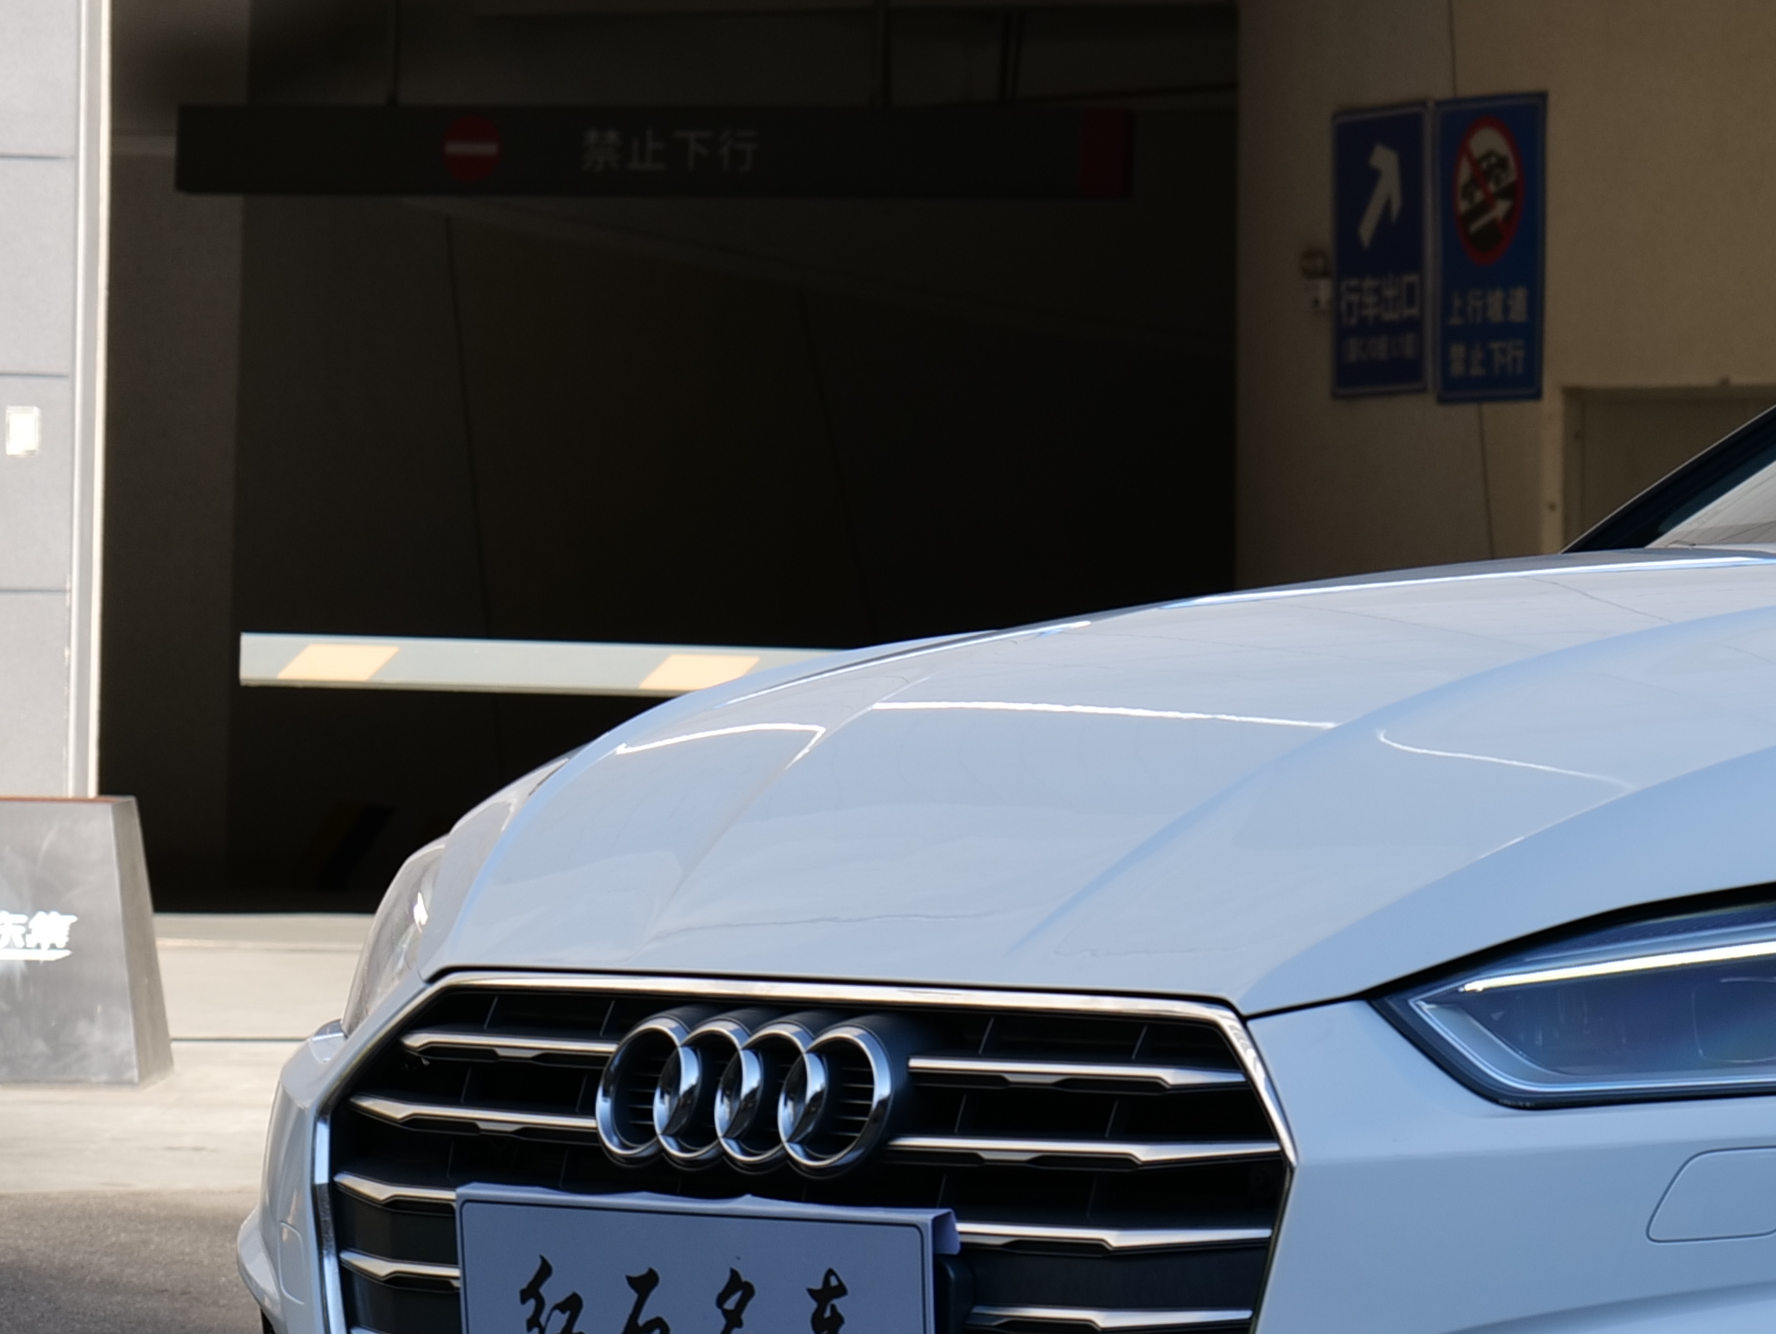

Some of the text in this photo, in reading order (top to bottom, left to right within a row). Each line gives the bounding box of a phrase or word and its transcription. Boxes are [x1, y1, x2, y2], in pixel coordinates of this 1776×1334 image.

[580, 129, 762, 173] 禁止下行
[1339, 272, 1421, 327] 行车出口
